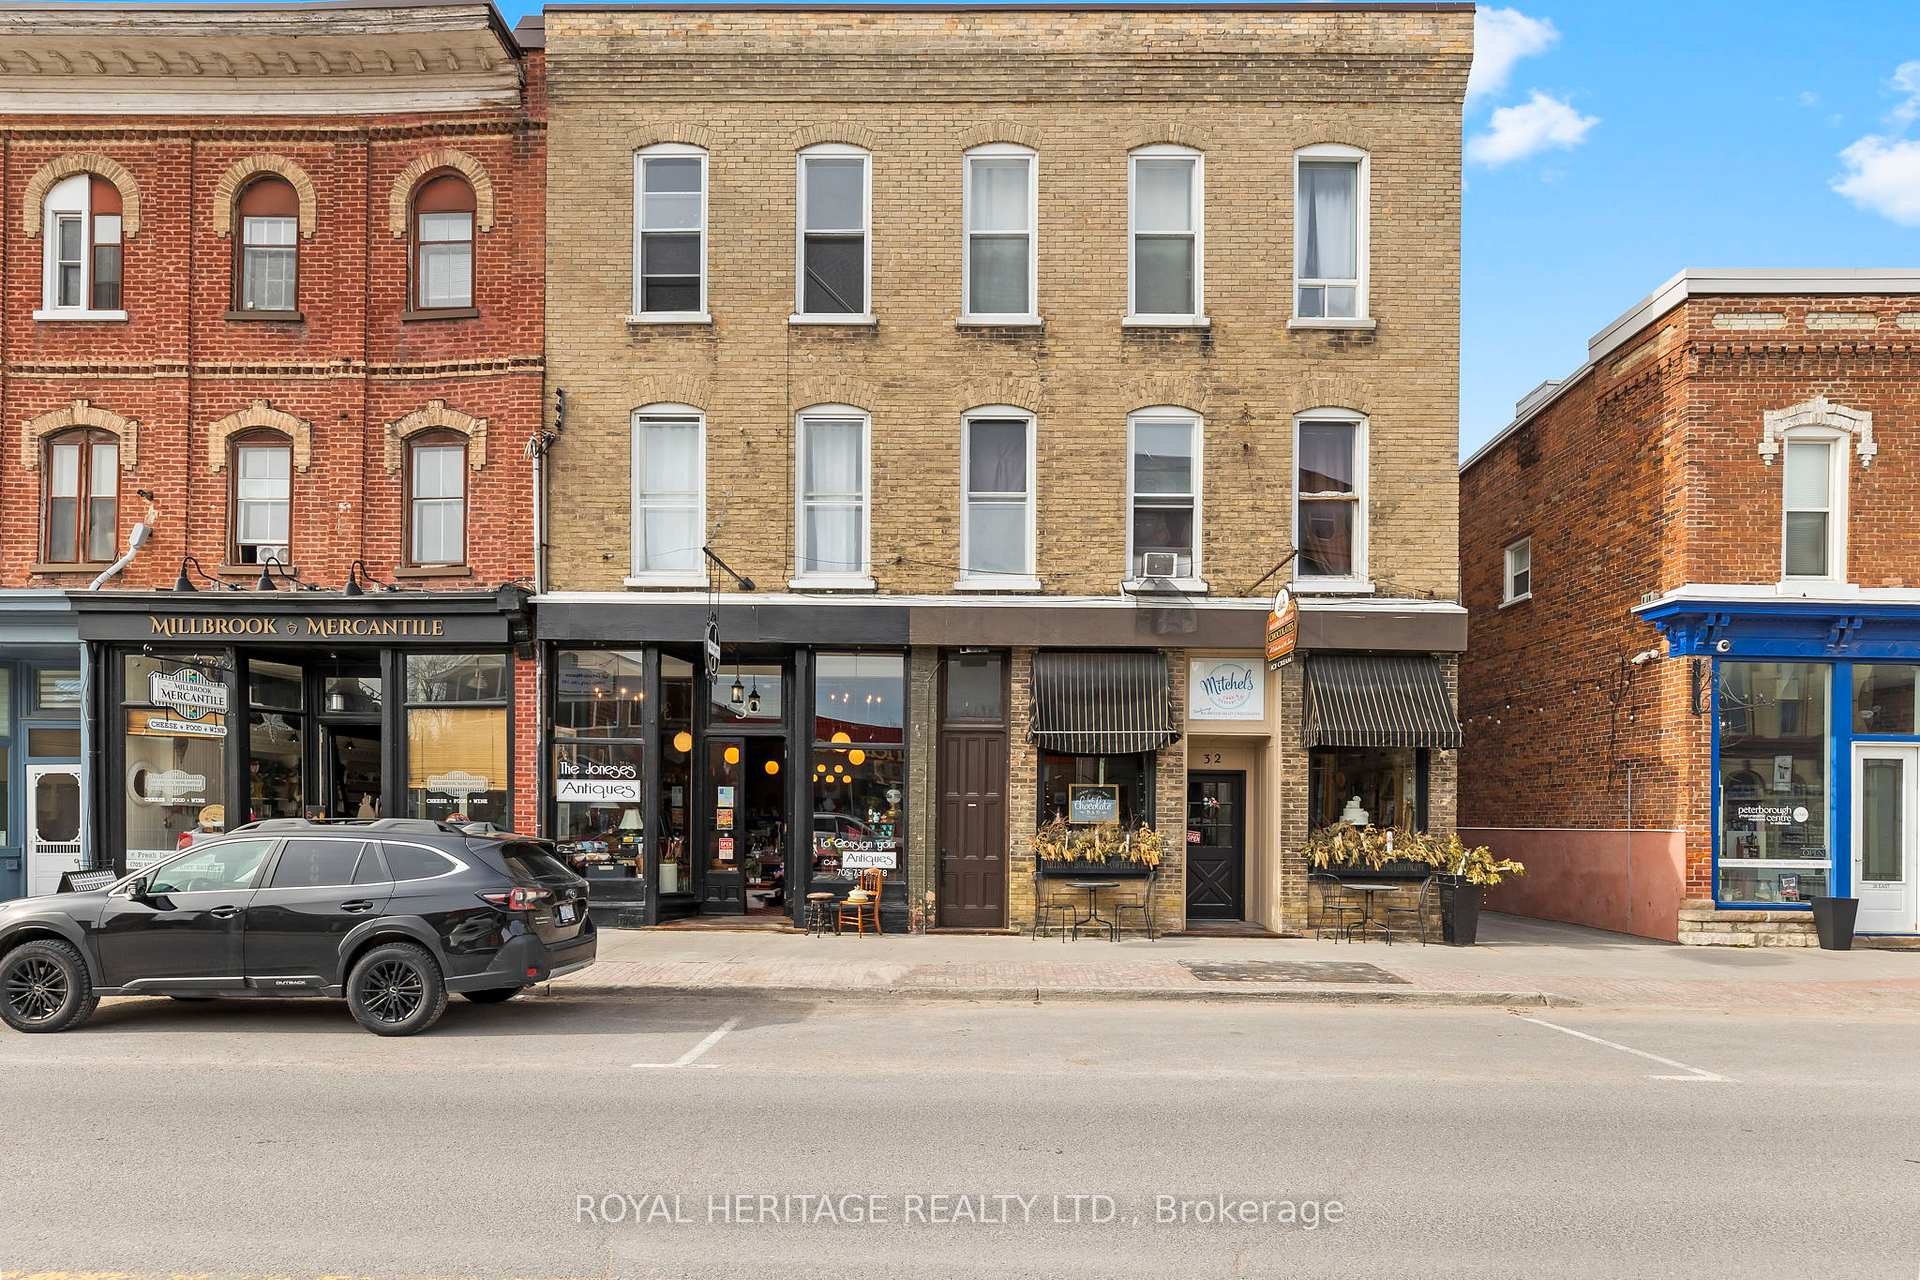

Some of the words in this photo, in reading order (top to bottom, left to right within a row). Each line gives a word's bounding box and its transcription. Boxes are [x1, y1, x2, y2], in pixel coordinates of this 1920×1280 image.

[150, 615, 278, 638] MILLBROOK
[306, 617, 444, 638] MERCANTILE
[1200, 669, 1254, 696] Mitchel's
[161, 688, 224, 706] MERCANTILE
[1203, 753, 1221, 764] 32
[560, 761, 579, 775] The
[585, 761, 636, 779] Joneses
[561, 782, 636, 799] Antiques
[1738, 805, 1792, 815] peterborough
[1766, 814, 1792, 822] centre
[846, 853, 894, 866] Antiques
